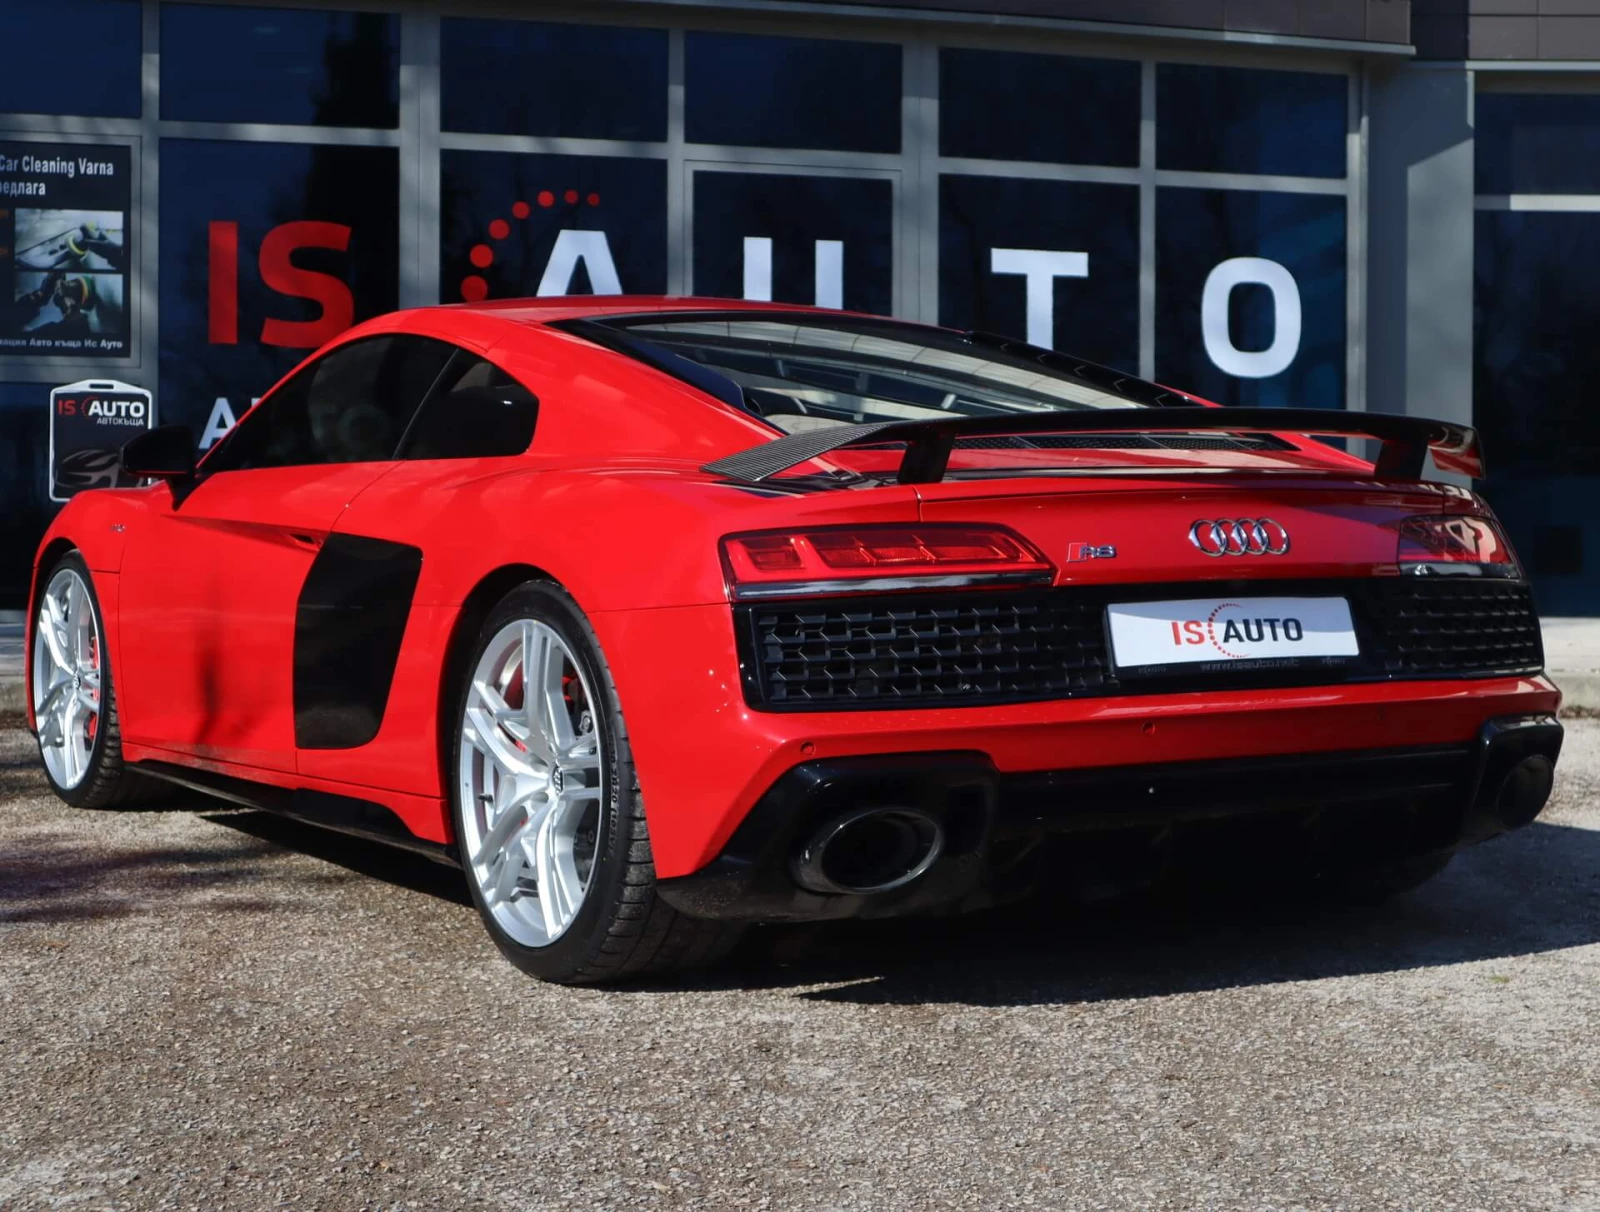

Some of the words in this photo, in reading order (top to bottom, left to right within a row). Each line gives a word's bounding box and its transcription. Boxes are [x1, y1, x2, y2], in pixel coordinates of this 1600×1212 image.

[0, 154, 19, 172] Car
[22, 155, 75, 178] Cleaning
[78, 157, 114, 176] Varna
[208, 220, 354, 349] IS
[29, 338, 53, 347] Авто
[100, 339, 123, 350] Ауто
[57, 400, 76, 415] IS
[88, 400, 145, 418] AUTO
[96, 418, 144, 426] АВТОКЪЩА
[1171, 620, 1206, 646] IS
[1223, 617, 1304, 643] AUTO
